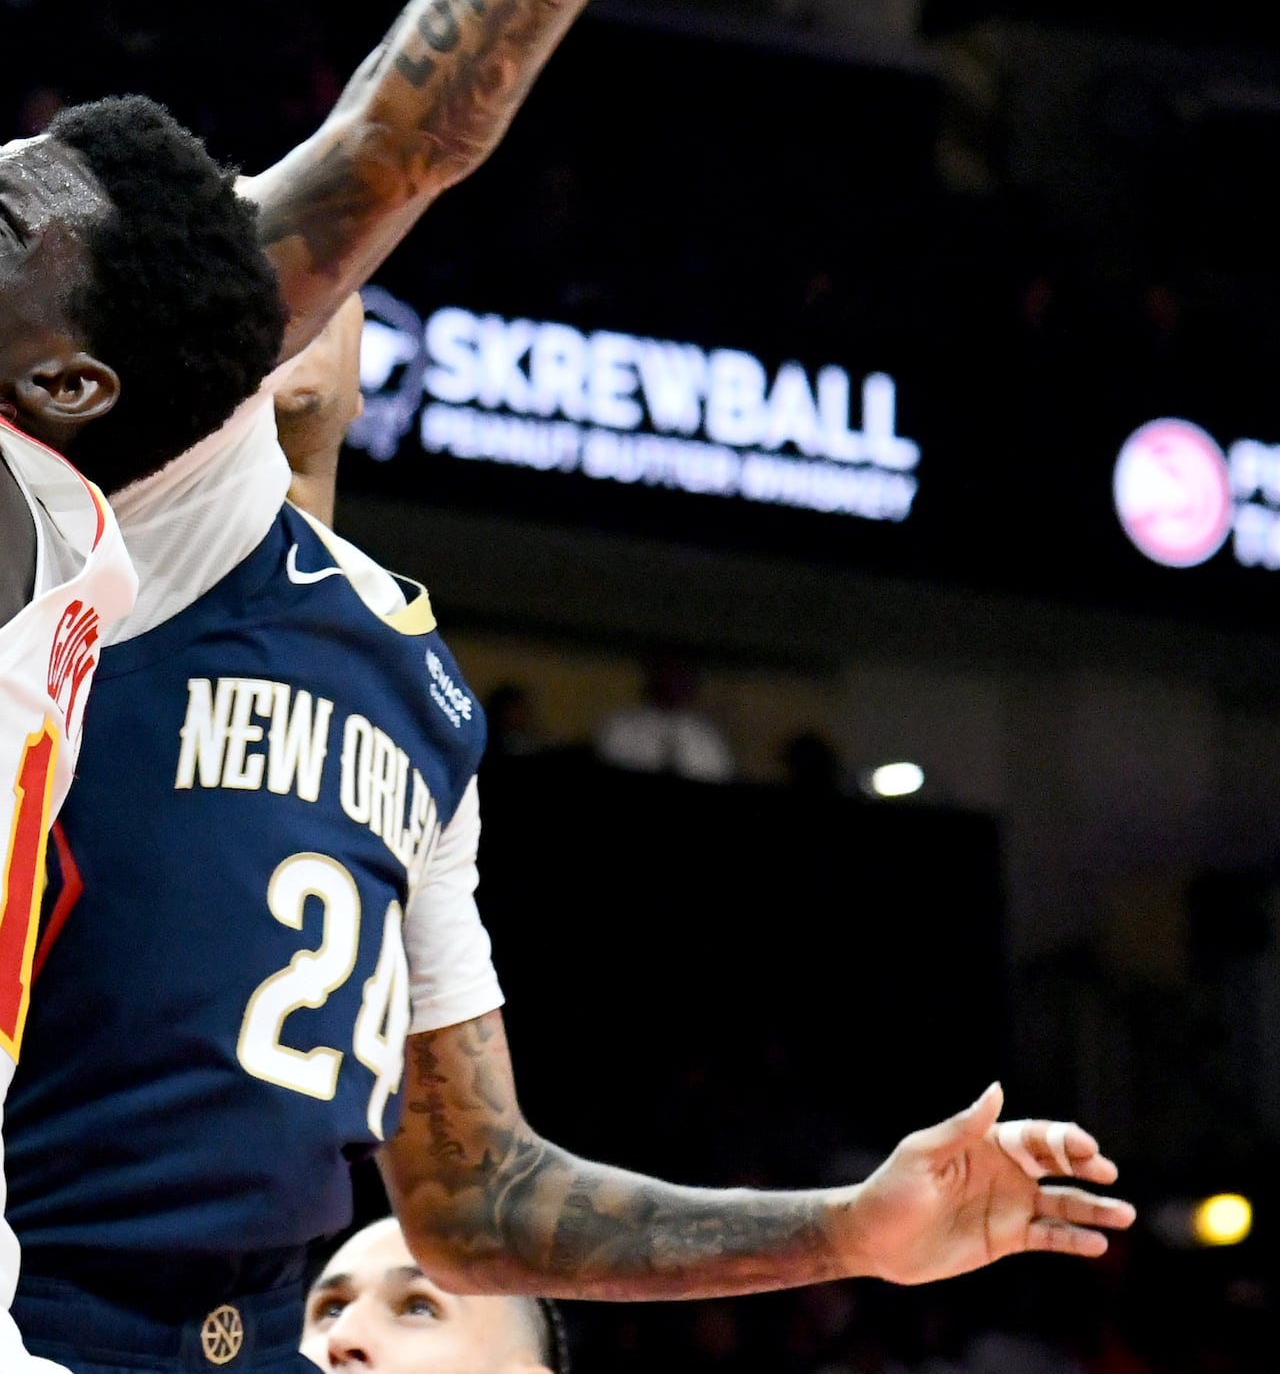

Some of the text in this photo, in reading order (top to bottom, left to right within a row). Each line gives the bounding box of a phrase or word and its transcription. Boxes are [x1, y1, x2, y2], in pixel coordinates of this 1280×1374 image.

[424, 307, 921, 471] SKREWBALL
[175, 678, 333, 803] NEW
[237, 851, 411, 1140] 24
